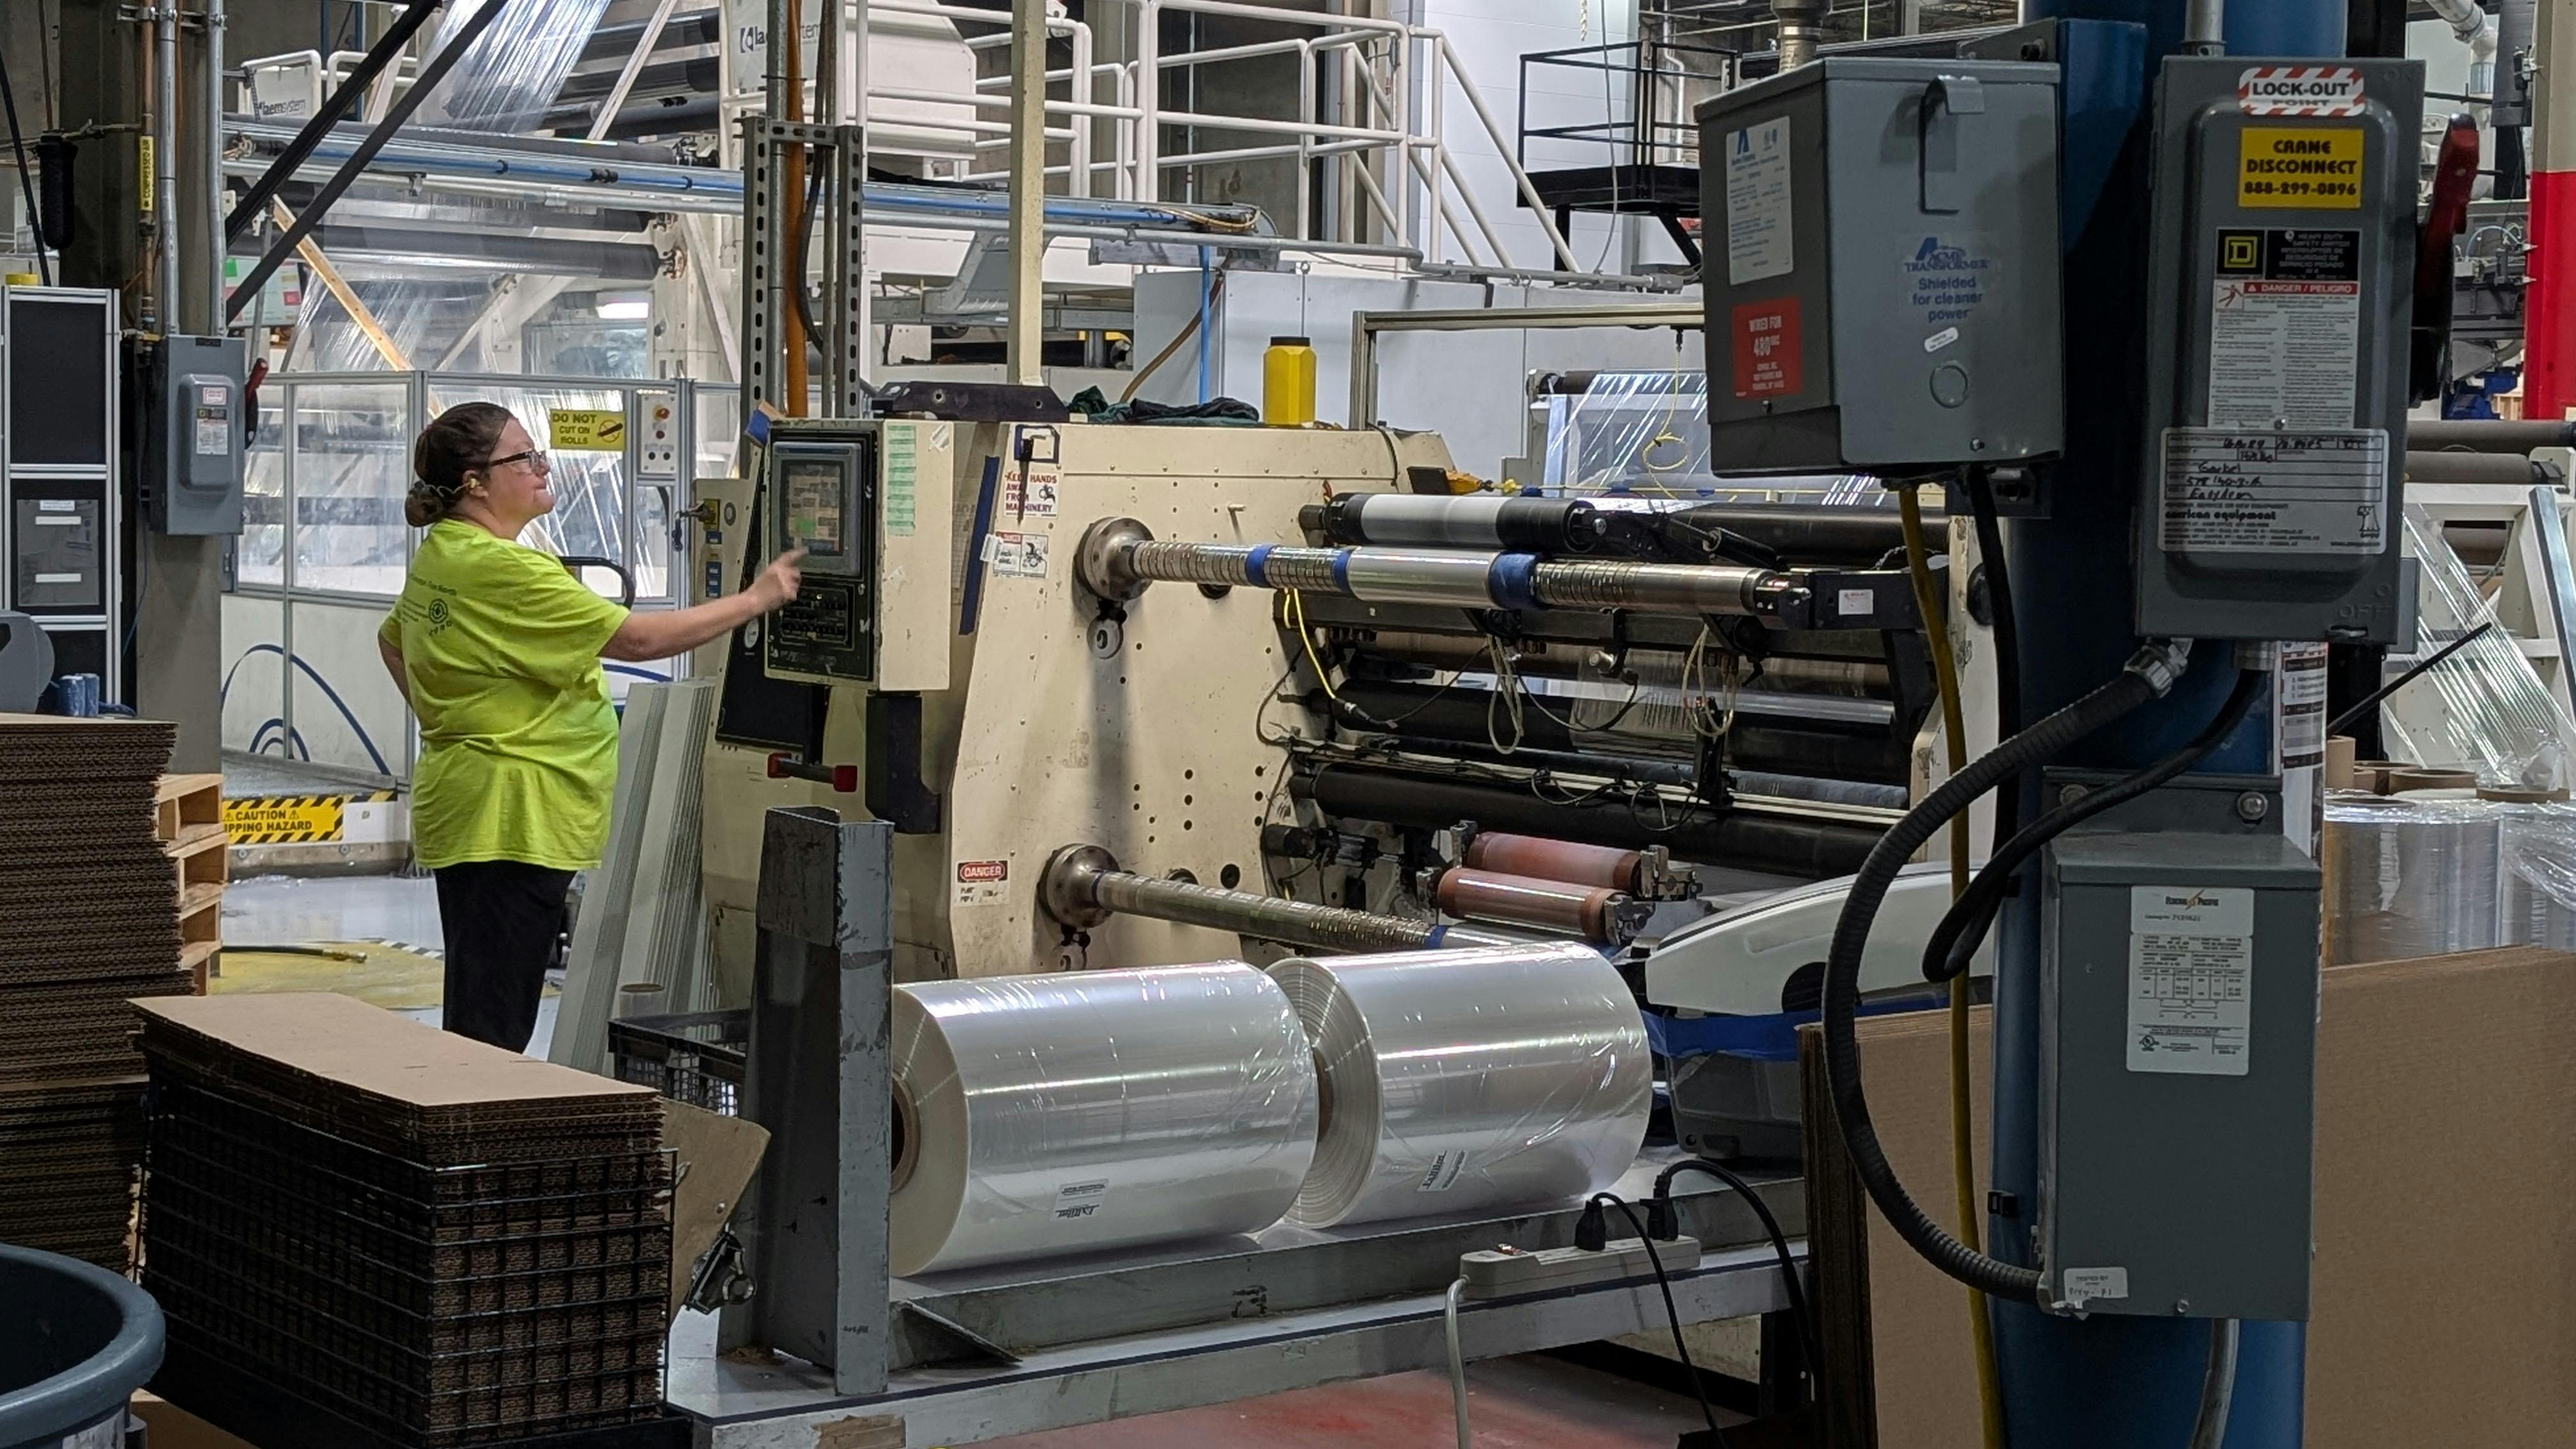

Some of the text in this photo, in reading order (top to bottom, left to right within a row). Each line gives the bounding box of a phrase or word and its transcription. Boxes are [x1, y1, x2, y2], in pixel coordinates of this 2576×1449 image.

[2253, 82, 2350, 95] LOCK-OUT
[2273, 140, 2331, 154] CRANE
[2246, 159, 2357, 174] DISCONNECT
[2244, 181, 2356, 195] 888-299-0896
[1919, 276, 1976, 290] Shielded
[2310, 284, 2352, 293] PELIGRO
[1913, 293, 1982, 305] for cleaner
[1928, 309, 1970, 323] power
[553, 413, 597, 424] DO NOT
[559, 425, 576, 434] CUT
[560, 436, 588, 445] ROLLS
[1030, 474, 1057, 484] HANDS
[1006, 503, 1053, 512] MAHINERY
[235, 810, 286, 820] CAUTION
[267, 821, 312, 832] HAZARD
[964, 866, 1001, 877] DANGER
